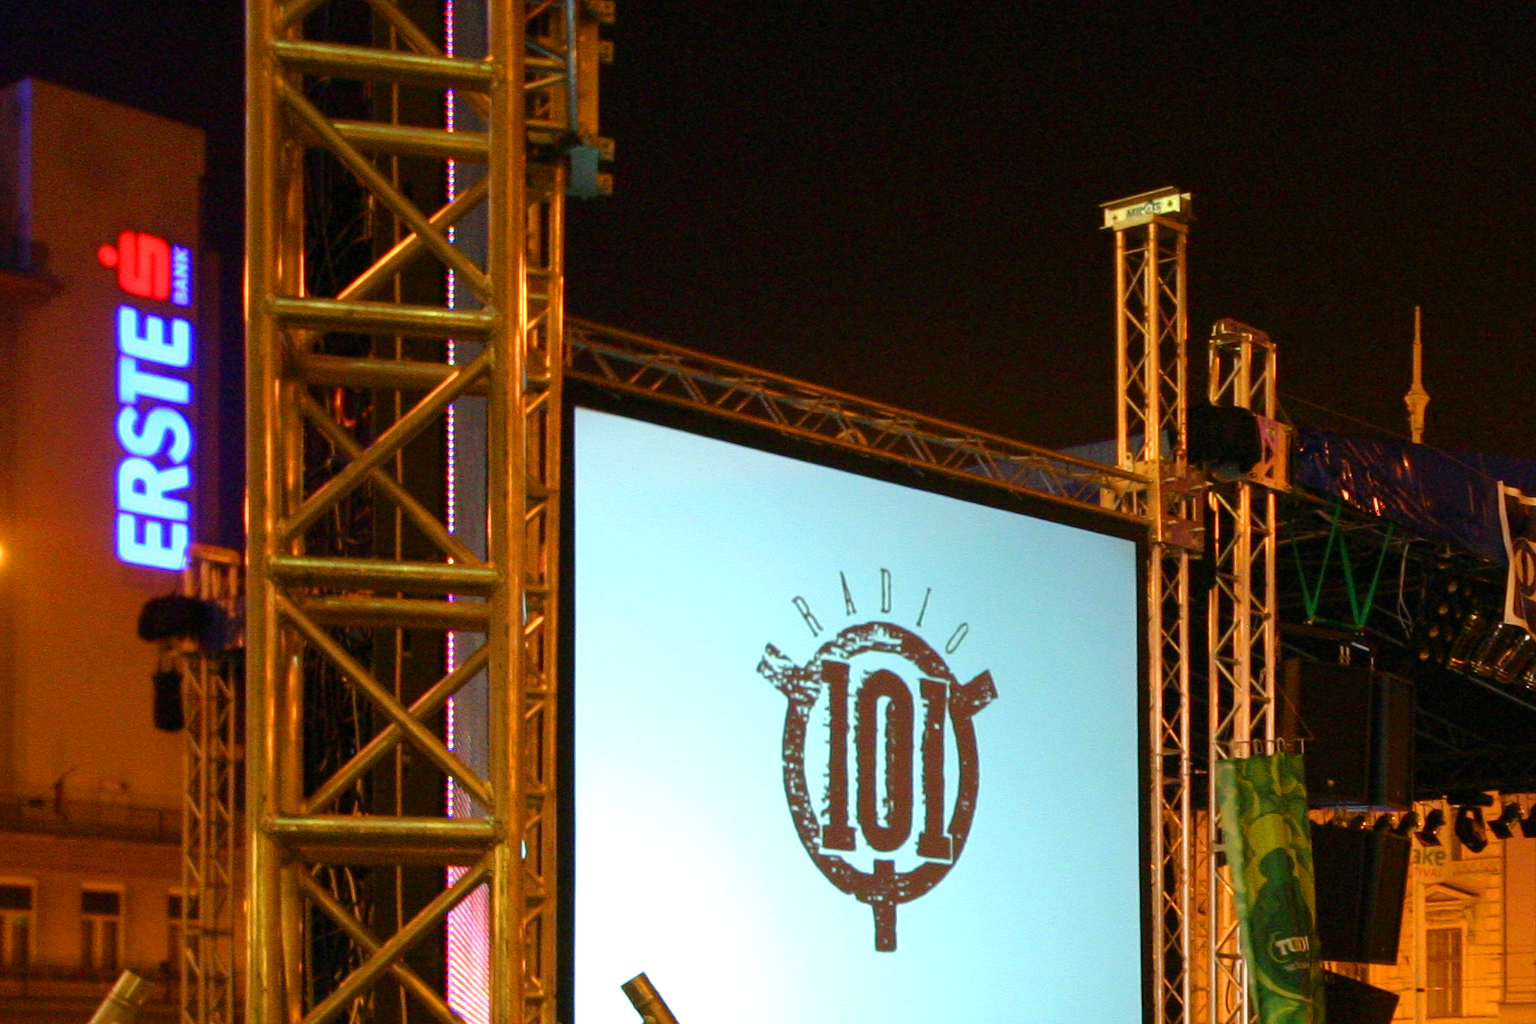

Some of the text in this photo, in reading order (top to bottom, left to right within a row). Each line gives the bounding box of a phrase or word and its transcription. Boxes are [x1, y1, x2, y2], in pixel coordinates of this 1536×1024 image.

[115, 304, 193, 572] ERSTE
[170, 244, 194, 308] BANK
[791, 567, 970, 655] RADIO
[820, 658, 953, 861] 101
